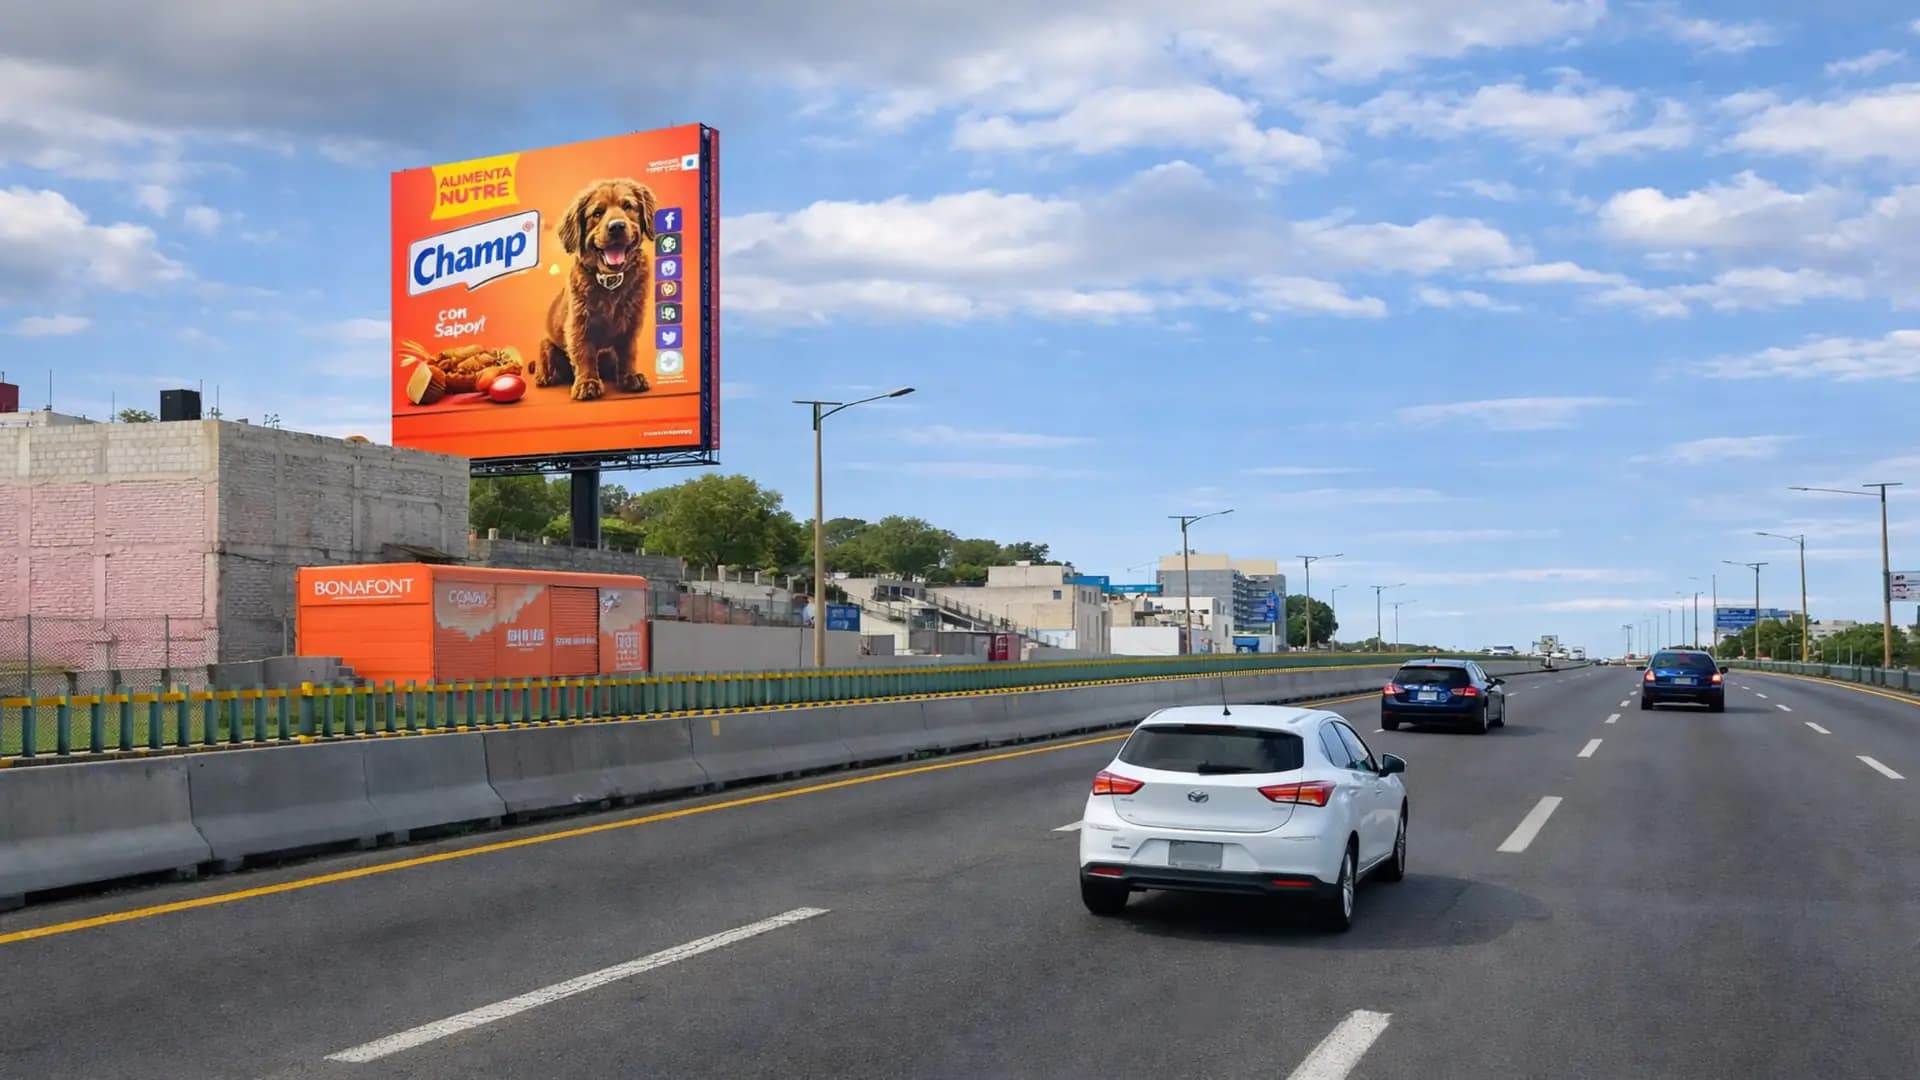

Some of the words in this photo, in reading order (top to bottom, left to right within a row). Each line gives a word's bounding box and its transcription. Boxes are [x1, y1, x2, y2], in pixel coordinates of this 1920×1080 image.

[440, 166, 512, 189] ALIMENTA
[440, 181, 510, 206] NUTRE
[414, 231, 526, 286] Champ
[438, 307, 468, 322] con
[314, 578, 414, 595] BONAFONT
